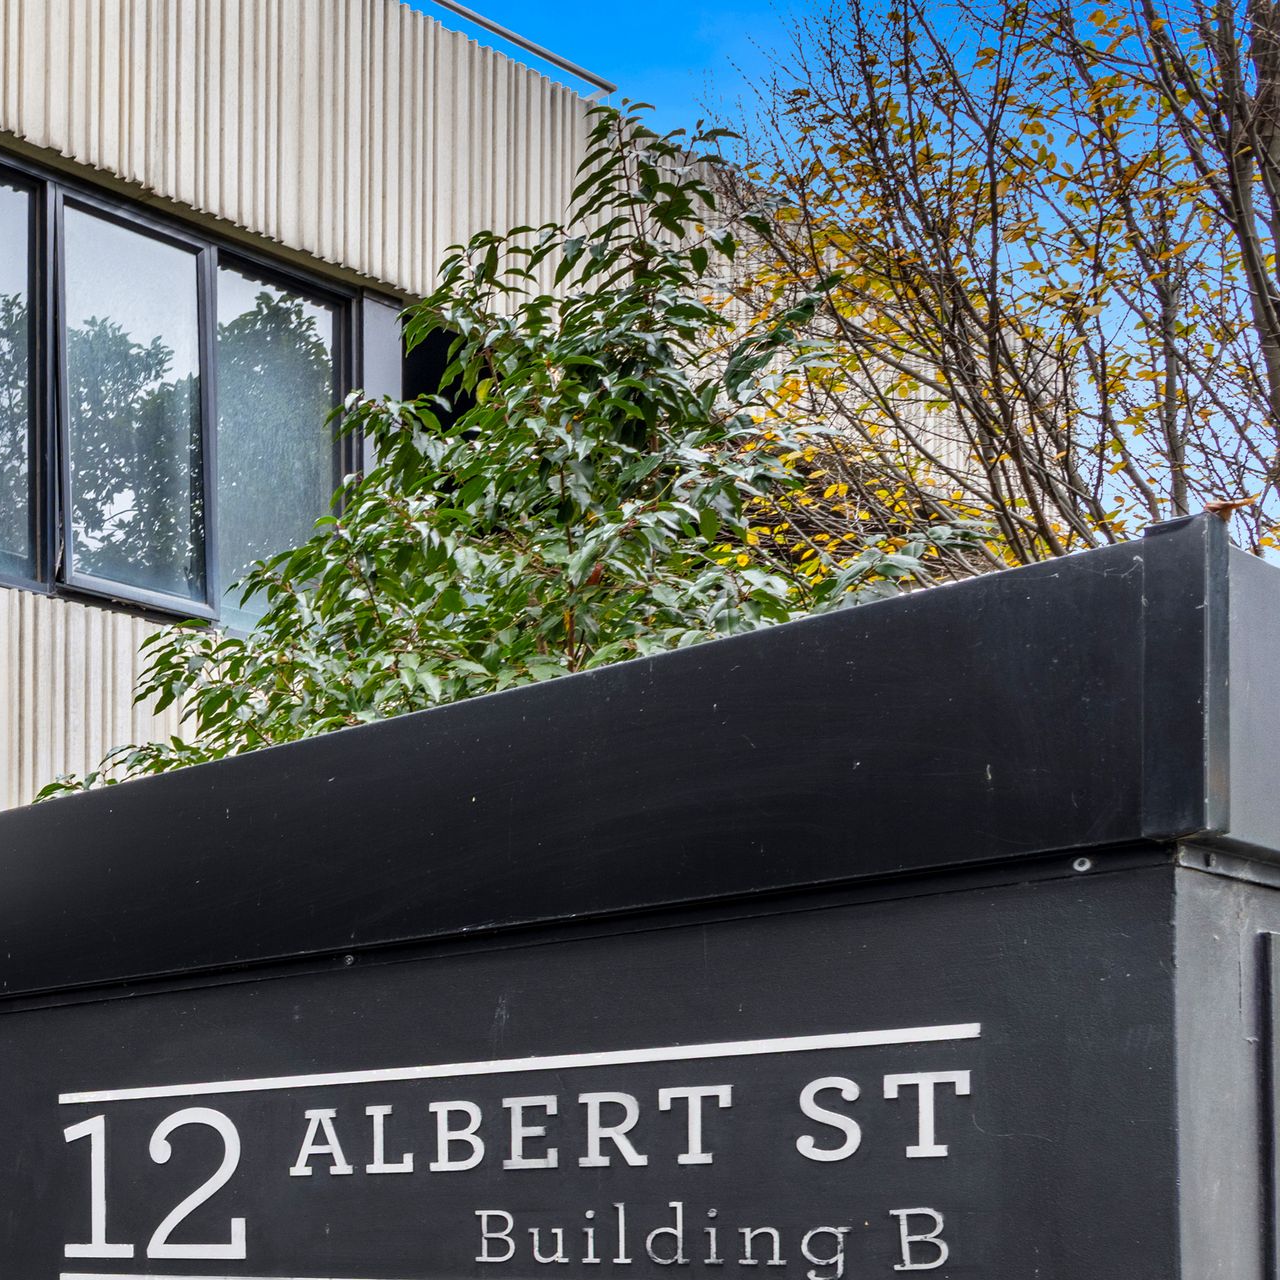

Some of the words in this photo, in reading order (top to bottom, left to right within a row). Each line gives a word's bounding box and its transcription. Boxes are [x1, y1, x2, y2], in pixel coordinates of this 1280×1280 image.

[63, 1106, 247, 1260] 12
[289, 1083, 735, 1177] ALBERT
[795, 1069, 972, 1162] ST
[888, 1206, 950, 1271] B
